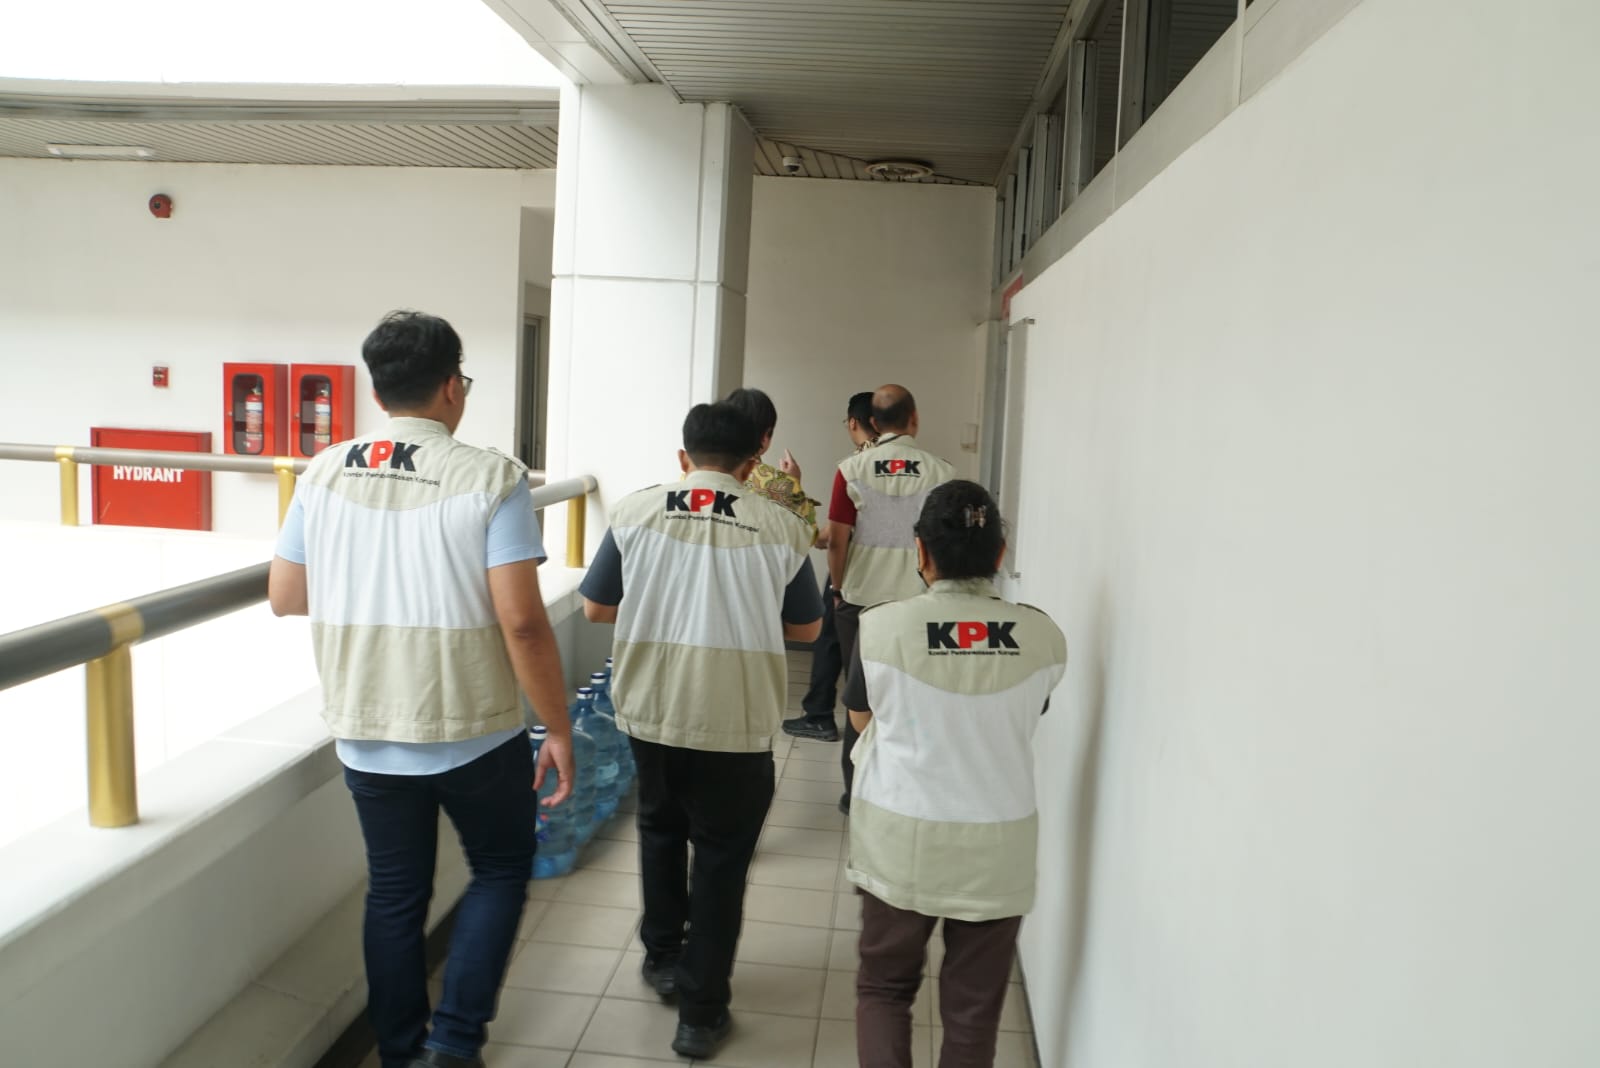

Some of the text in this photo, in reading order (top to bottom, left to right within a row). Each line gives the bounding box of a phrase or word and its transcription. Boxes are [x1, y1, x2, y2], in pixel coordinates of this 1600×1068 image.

[345, 440, 422, 472] KPK
[875, 459, 921, 475] KPK
[113, 465, 184, 482] HYDRANT
[666, 488, 740, 518] KPK
[926, 621, 1020, 649] KPK
